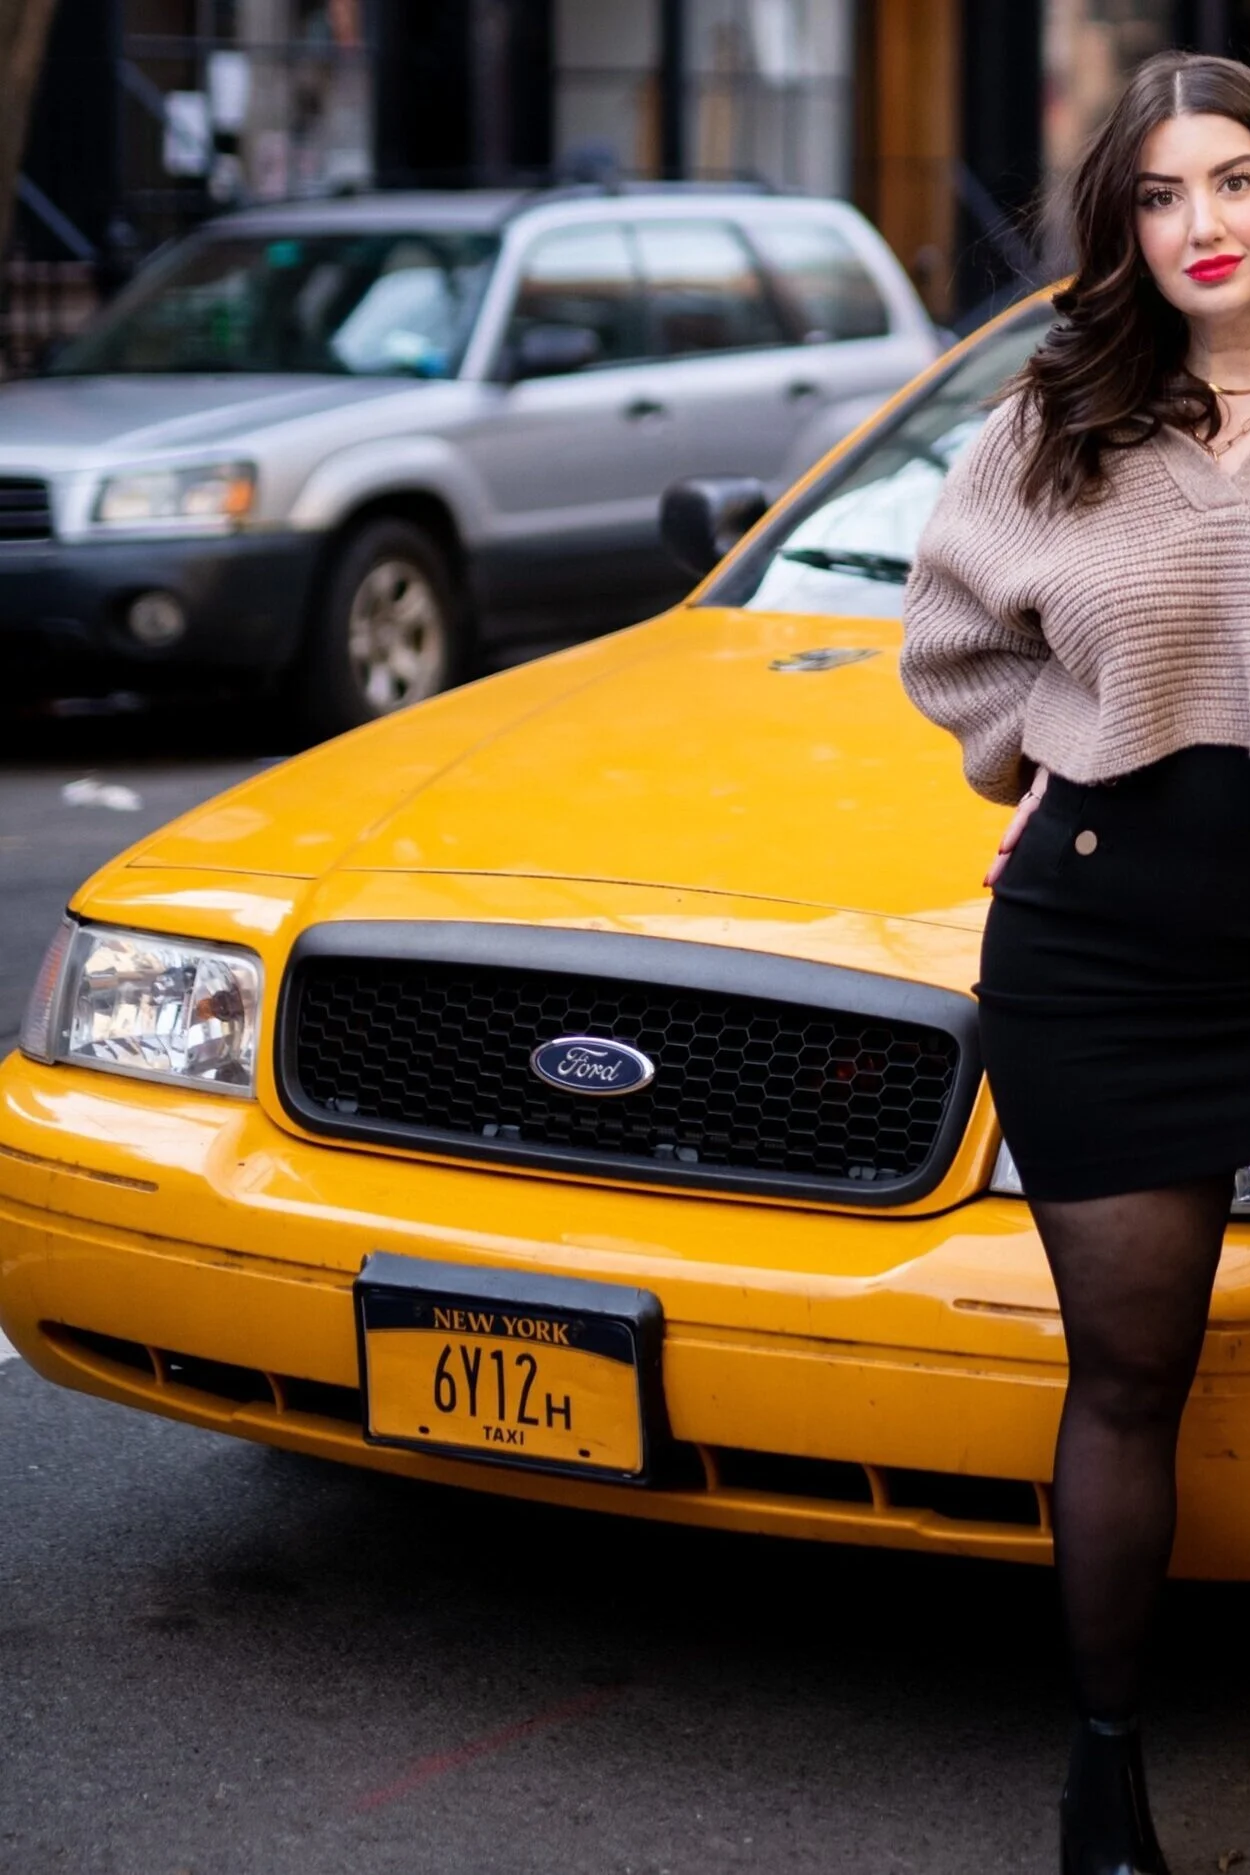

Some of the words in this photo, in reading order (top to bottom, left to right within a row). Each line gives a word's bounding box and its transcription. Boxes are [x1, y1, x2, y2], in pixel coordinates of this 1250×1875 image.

[557, 1046, 623, 1082] Ford
[432, 1306, 495, 1333] NEW
[501, 1315, 570, 1345] YORK
[482, 1425, 525, 1446] TAXI
